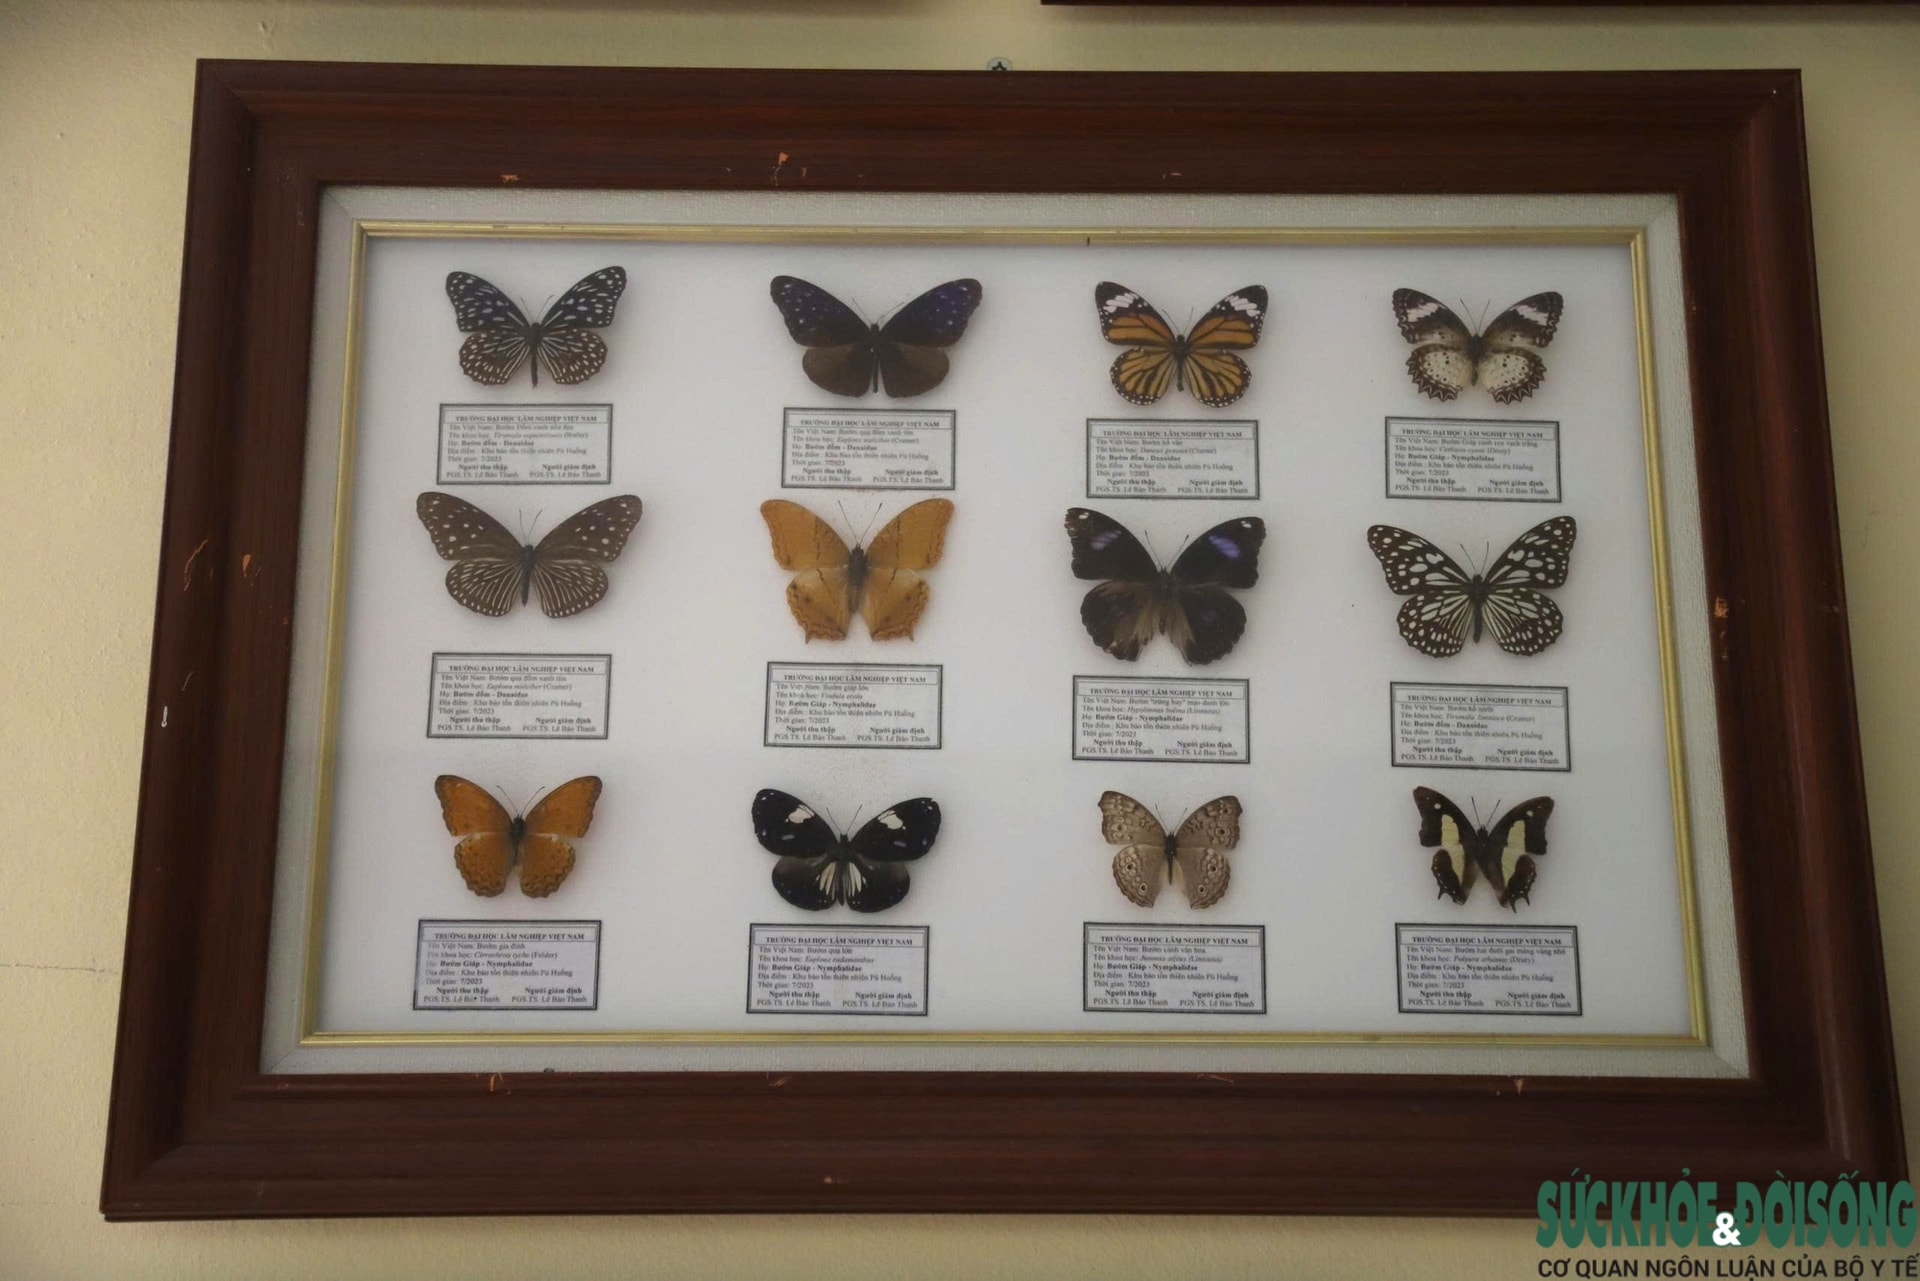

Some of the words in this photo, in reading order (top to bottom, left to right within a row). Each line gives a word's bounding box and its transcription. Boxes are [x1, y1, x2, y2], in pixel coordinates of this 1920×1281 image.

[1169, 690, 1196, 698] NGHIỆP
[1488, 697, 1515, 705] NGHIỆP
[519, 933, 547, 941] NGHIỆP
[848, 938, 875, 946] NGHIỆP
[877, 938, 893, 946] VIỆT
[1183, 937, 1211, 946] NGHIỆP
[1213, 938, 1229, 946] VIỆT
[1496, 938, 1524, 946] NGHIỆP
[1525, 938, 1542, 946] VIỆT
